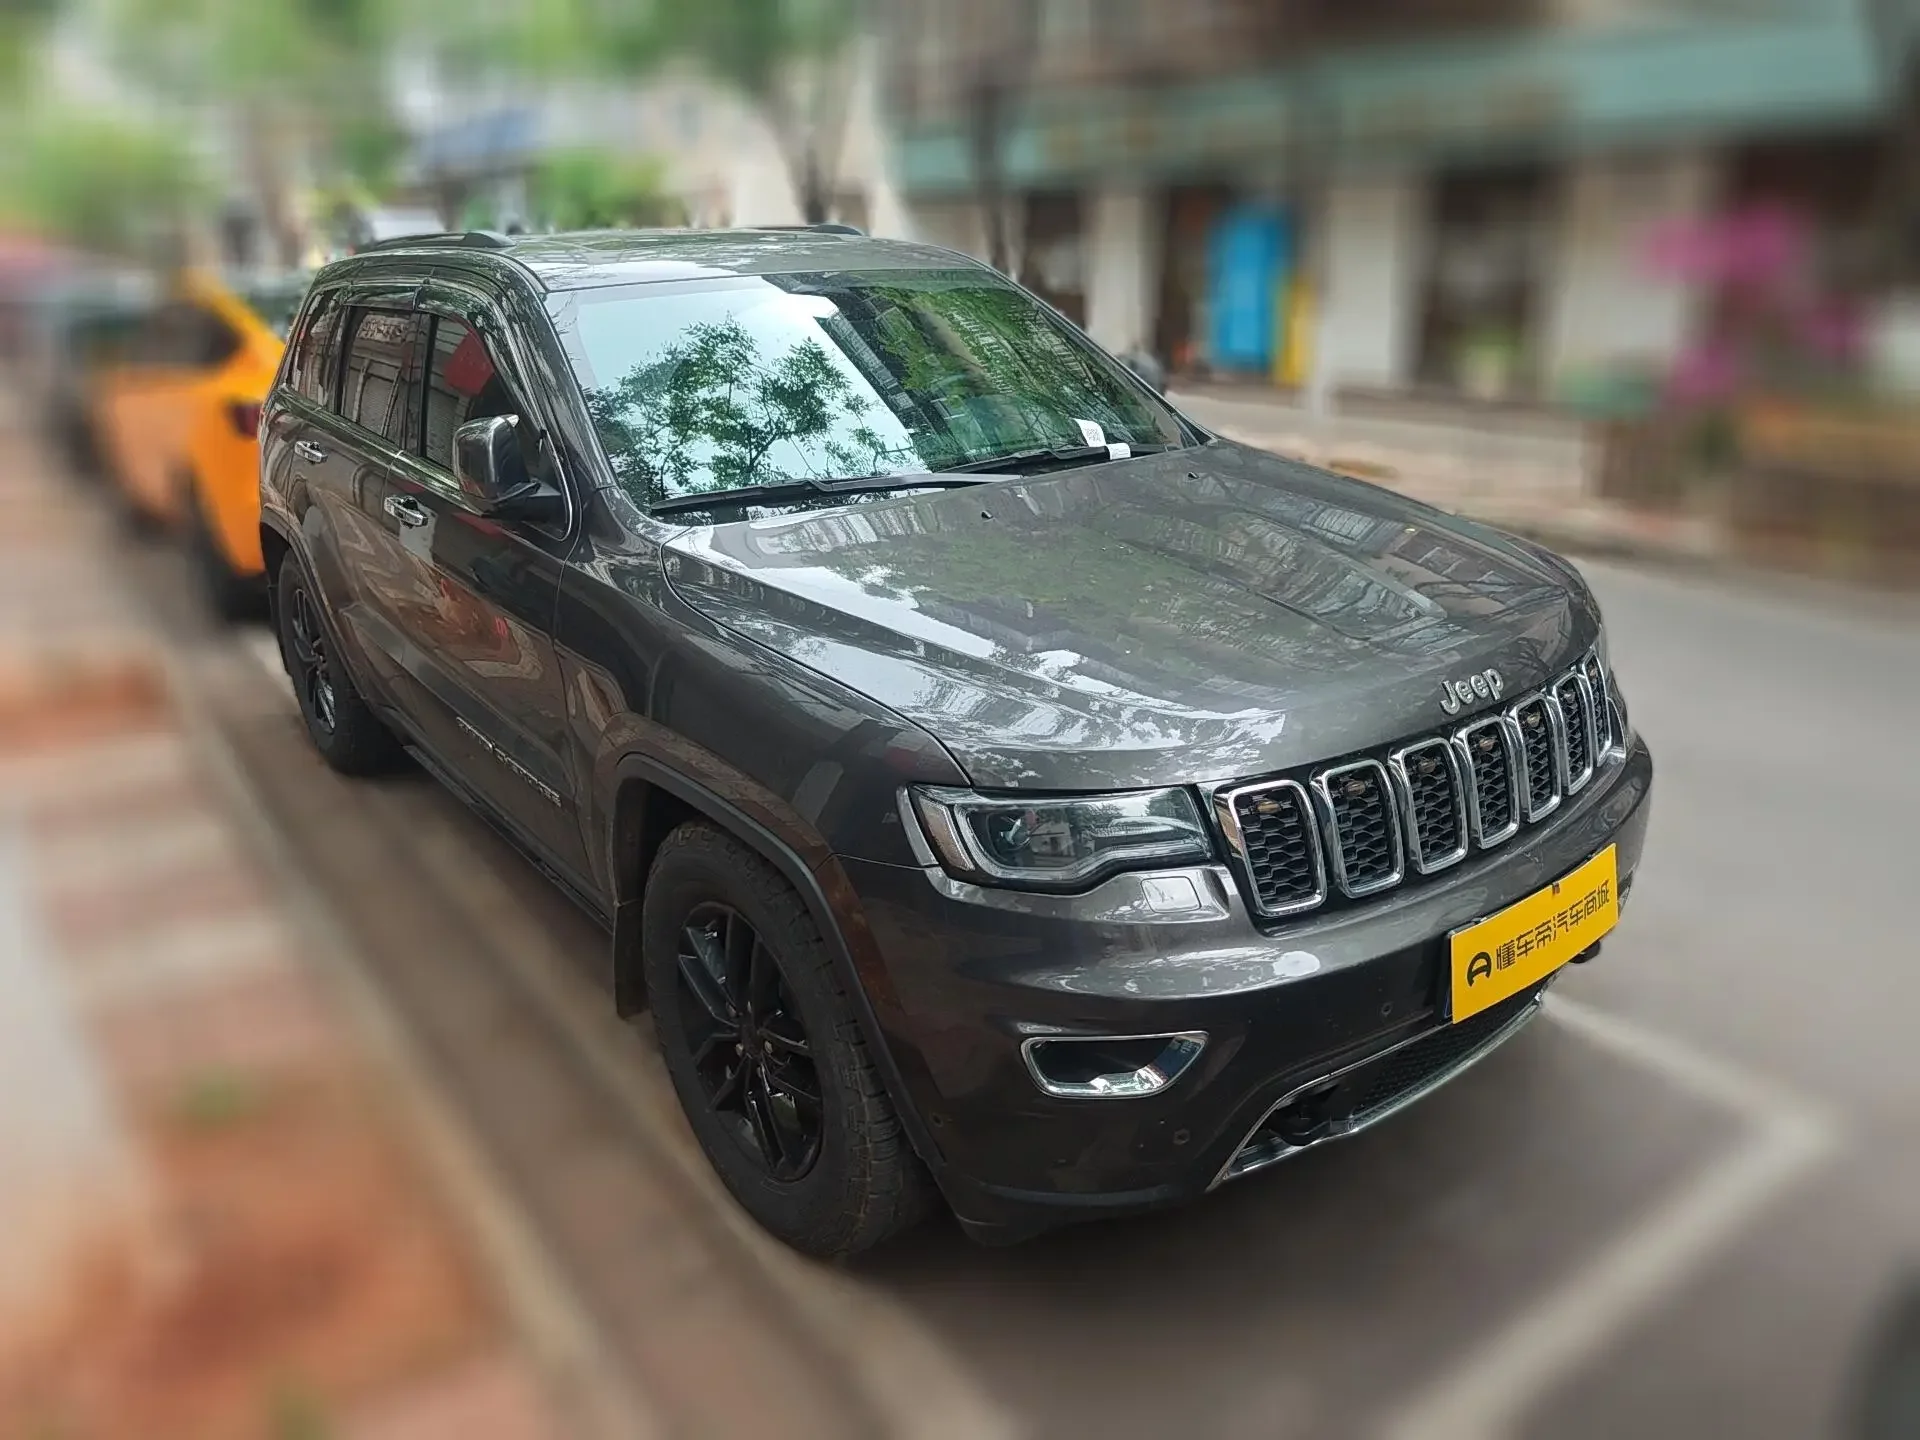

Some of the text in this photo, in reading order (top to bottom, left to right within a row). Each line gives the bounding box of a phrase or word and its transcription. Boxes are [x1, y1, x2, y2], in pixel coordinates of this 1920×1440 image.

[1440, 668, 1504, 714] Jeep
[1496, 879, 1609, 970] 懂车帝汽车商城
